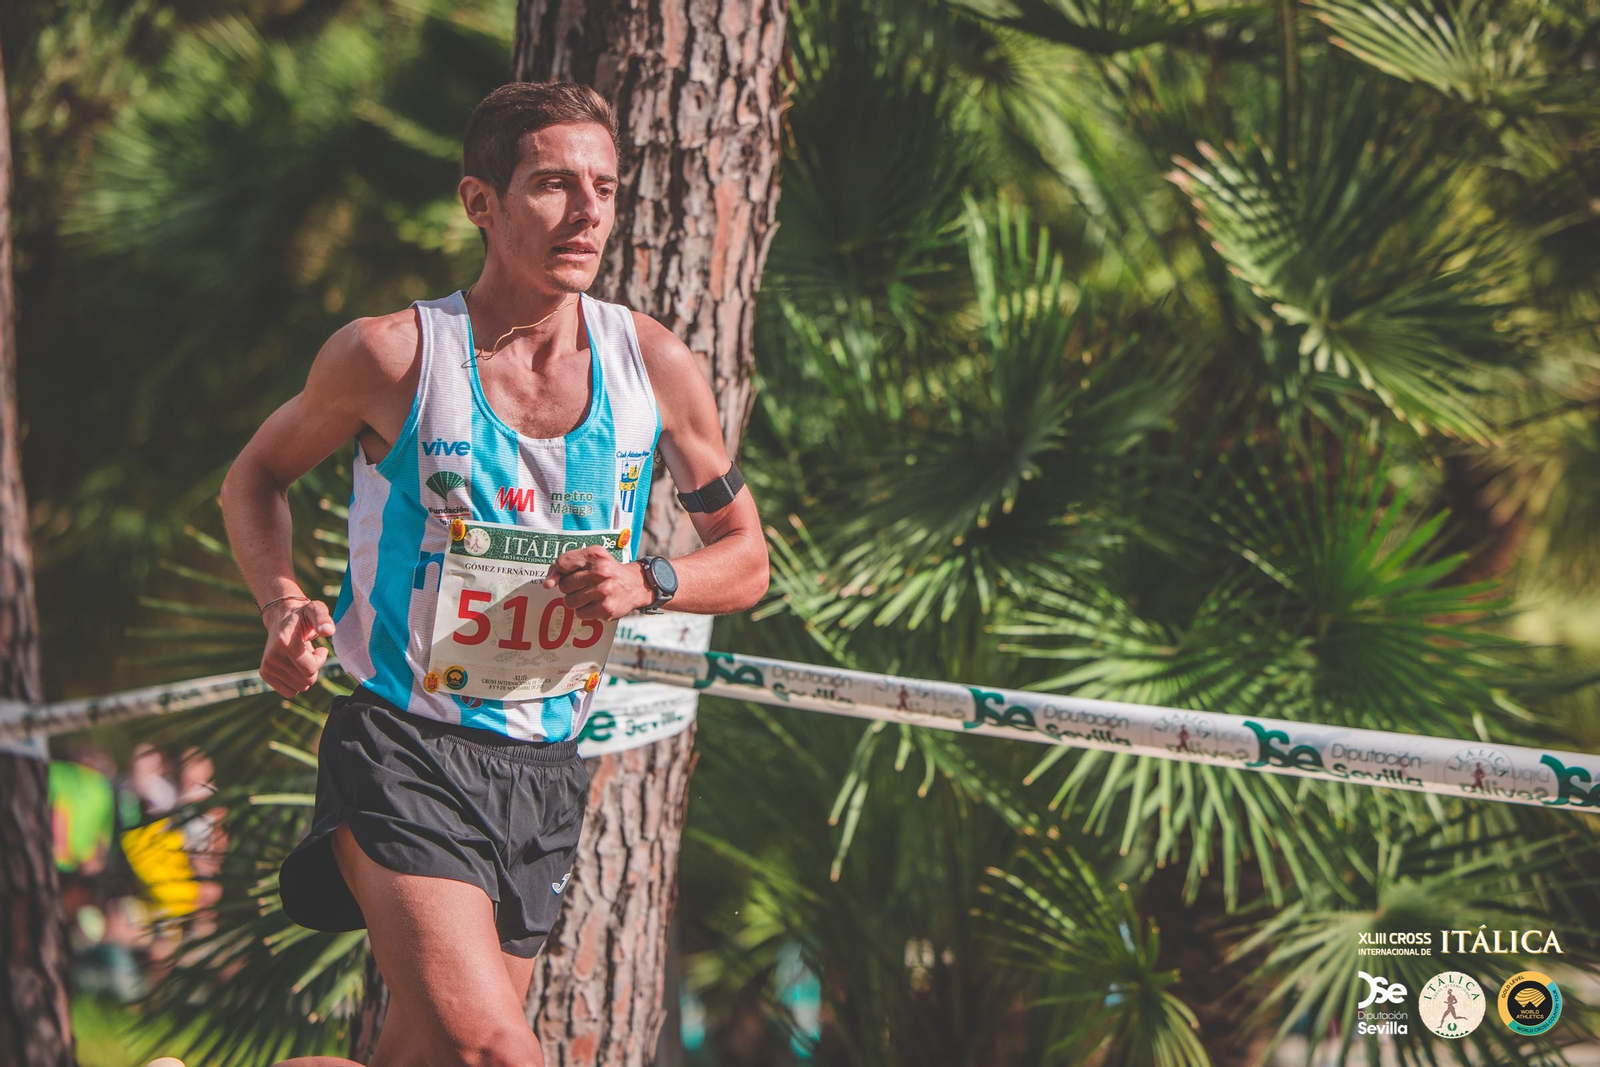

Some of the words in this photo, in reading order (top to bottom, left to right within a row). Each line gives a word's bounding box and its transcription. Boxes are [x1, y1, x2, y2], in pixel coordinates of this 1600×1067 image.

[421, 437, 471, 456] vive
[551, 491, 593, 501] metro
[428, 506, 470, 514] Fundación
[550, 503, 593, 517] Málaga
[464, 562, 496, 573] GÓMEZ
[1331, 743, 1422, 768] Diputación
[1332, 763, 1424, 788] Sevilla
